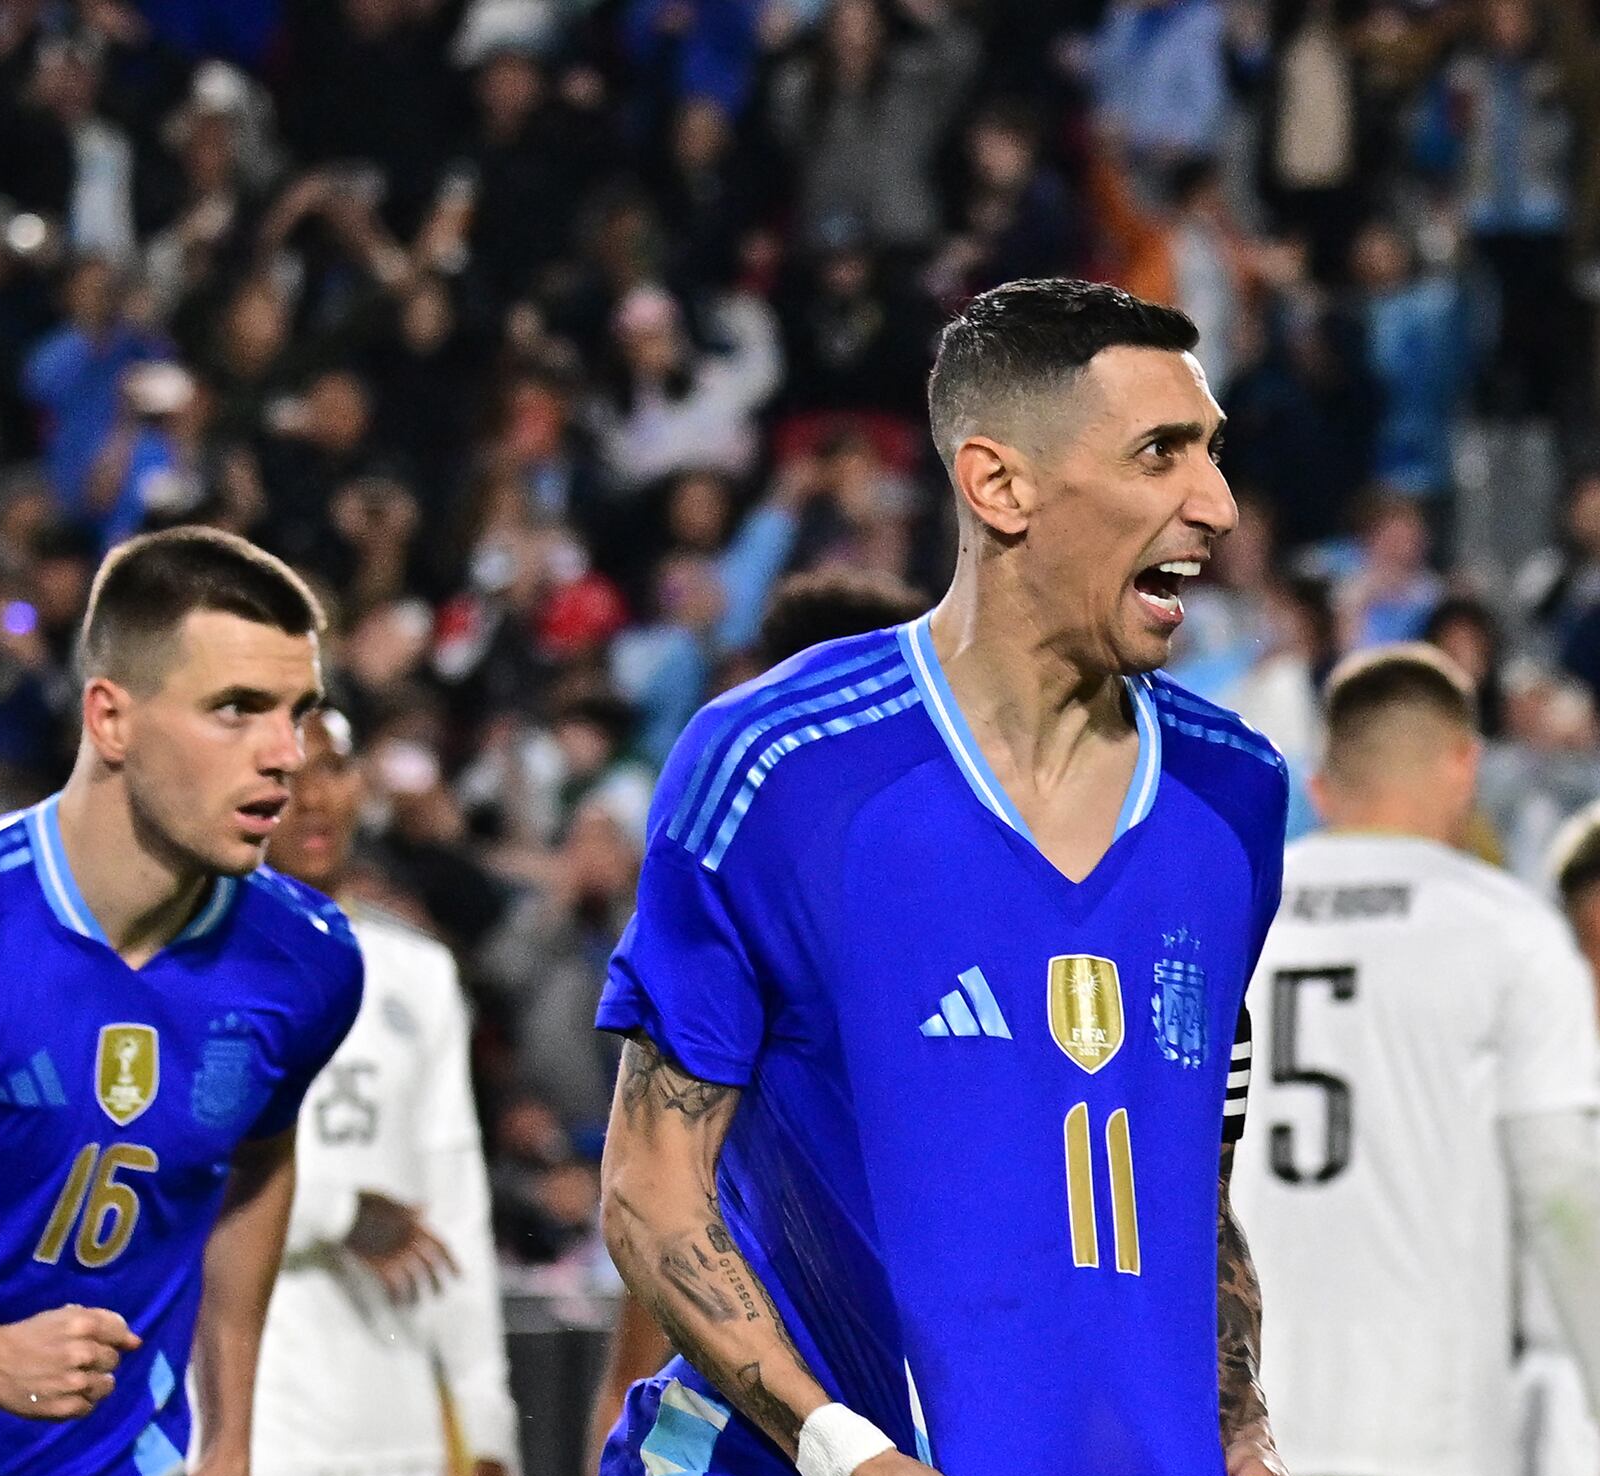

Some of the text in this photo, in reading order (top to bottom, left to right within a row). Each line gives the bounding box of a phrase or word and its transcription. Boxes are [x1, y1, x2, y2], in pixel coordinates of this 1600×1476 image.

[1268, 964, 1357, 1185] 5
[32, 1142, 160, 1269] 16
[1063, 1101, 1141, 1277] 11
